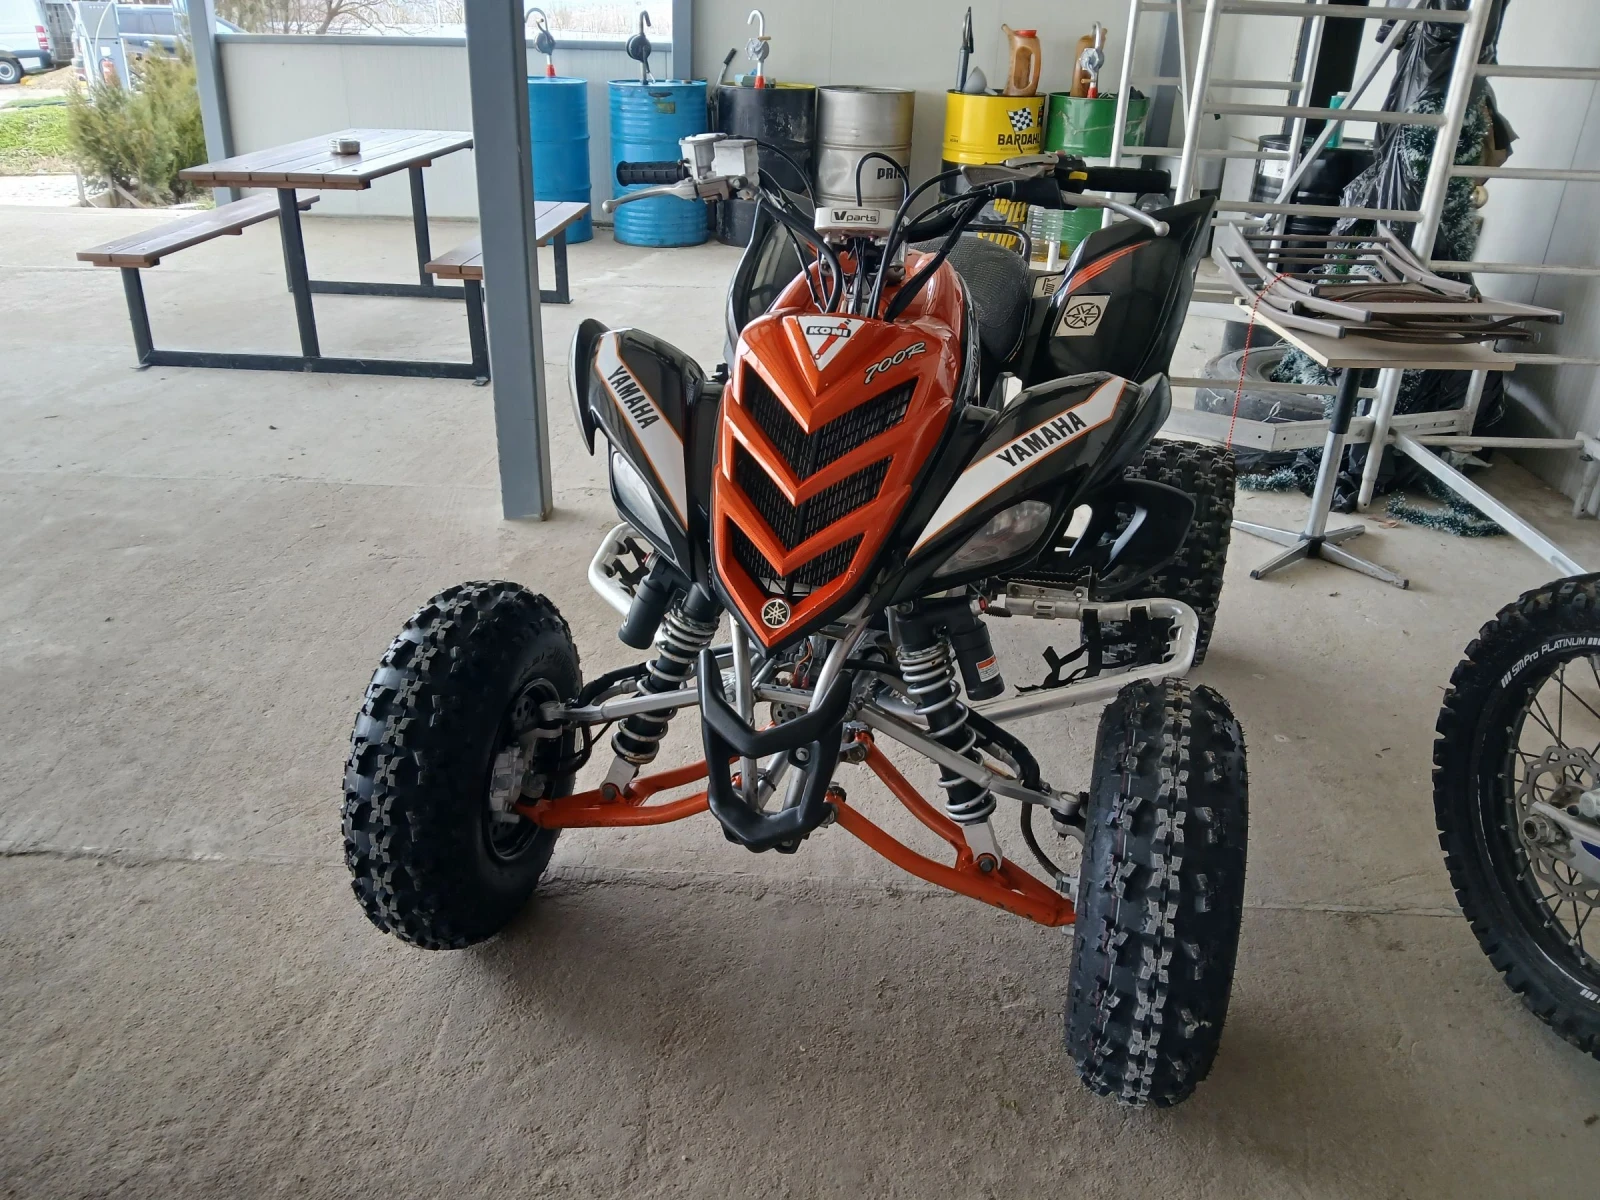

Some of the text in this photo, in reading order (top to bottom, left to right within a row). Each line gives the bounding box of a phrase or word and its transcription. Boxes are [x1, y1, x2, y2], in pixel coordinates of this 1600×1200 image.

[997, 133, 1041, 146] BARDAHL
[876, 166, 910, 180] PRI
[808, 327, 849, 336] KONI
[863, 341, 926, 384] 700R
[607, 365, 660, 429] YAMAHA
[996, 411, 1087, 467] YAMAHA
[1541, 637, 1586, 655] PLATINUM
